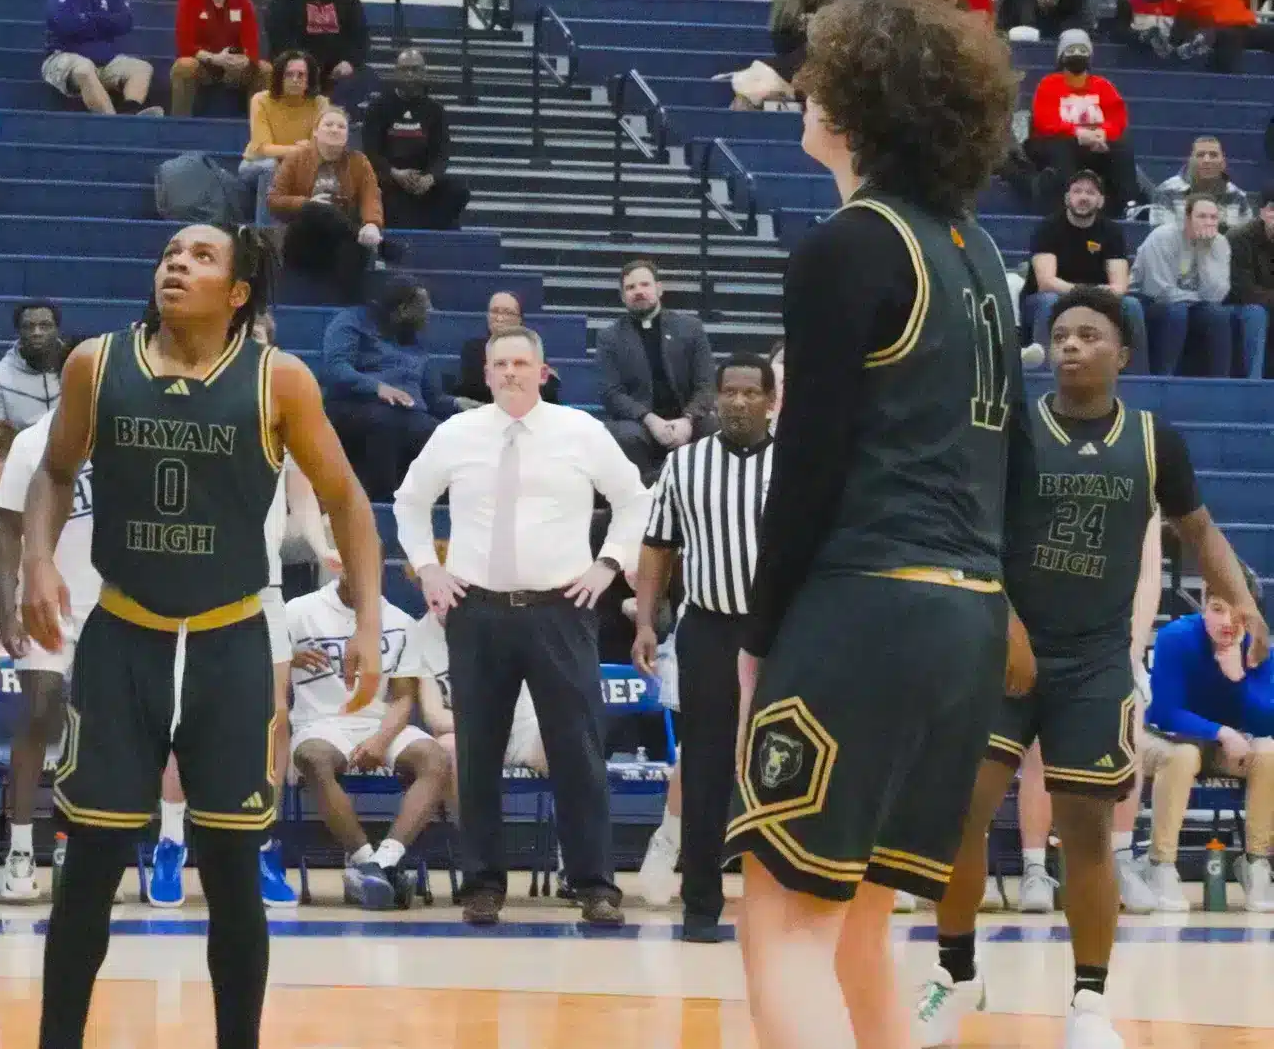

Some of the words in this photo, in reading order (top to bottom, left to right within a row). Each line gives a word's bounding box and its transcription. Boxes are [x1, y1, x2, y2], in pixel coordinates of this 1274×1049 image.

[963, 288, 1008, 431] 11
[114, 416, 237, 455] BRYAN
[155, 458, 188, 515] 0
[1038, 473, 1134, 502] BRYAN
[127, 521, 216, 554] HIGH
[1049, 501, 1106, 549] 24
[1032, 545, 1108, 579] HIGH
[600, 678, 647, 704] EP
[1206, 859, 1221, 876] G
